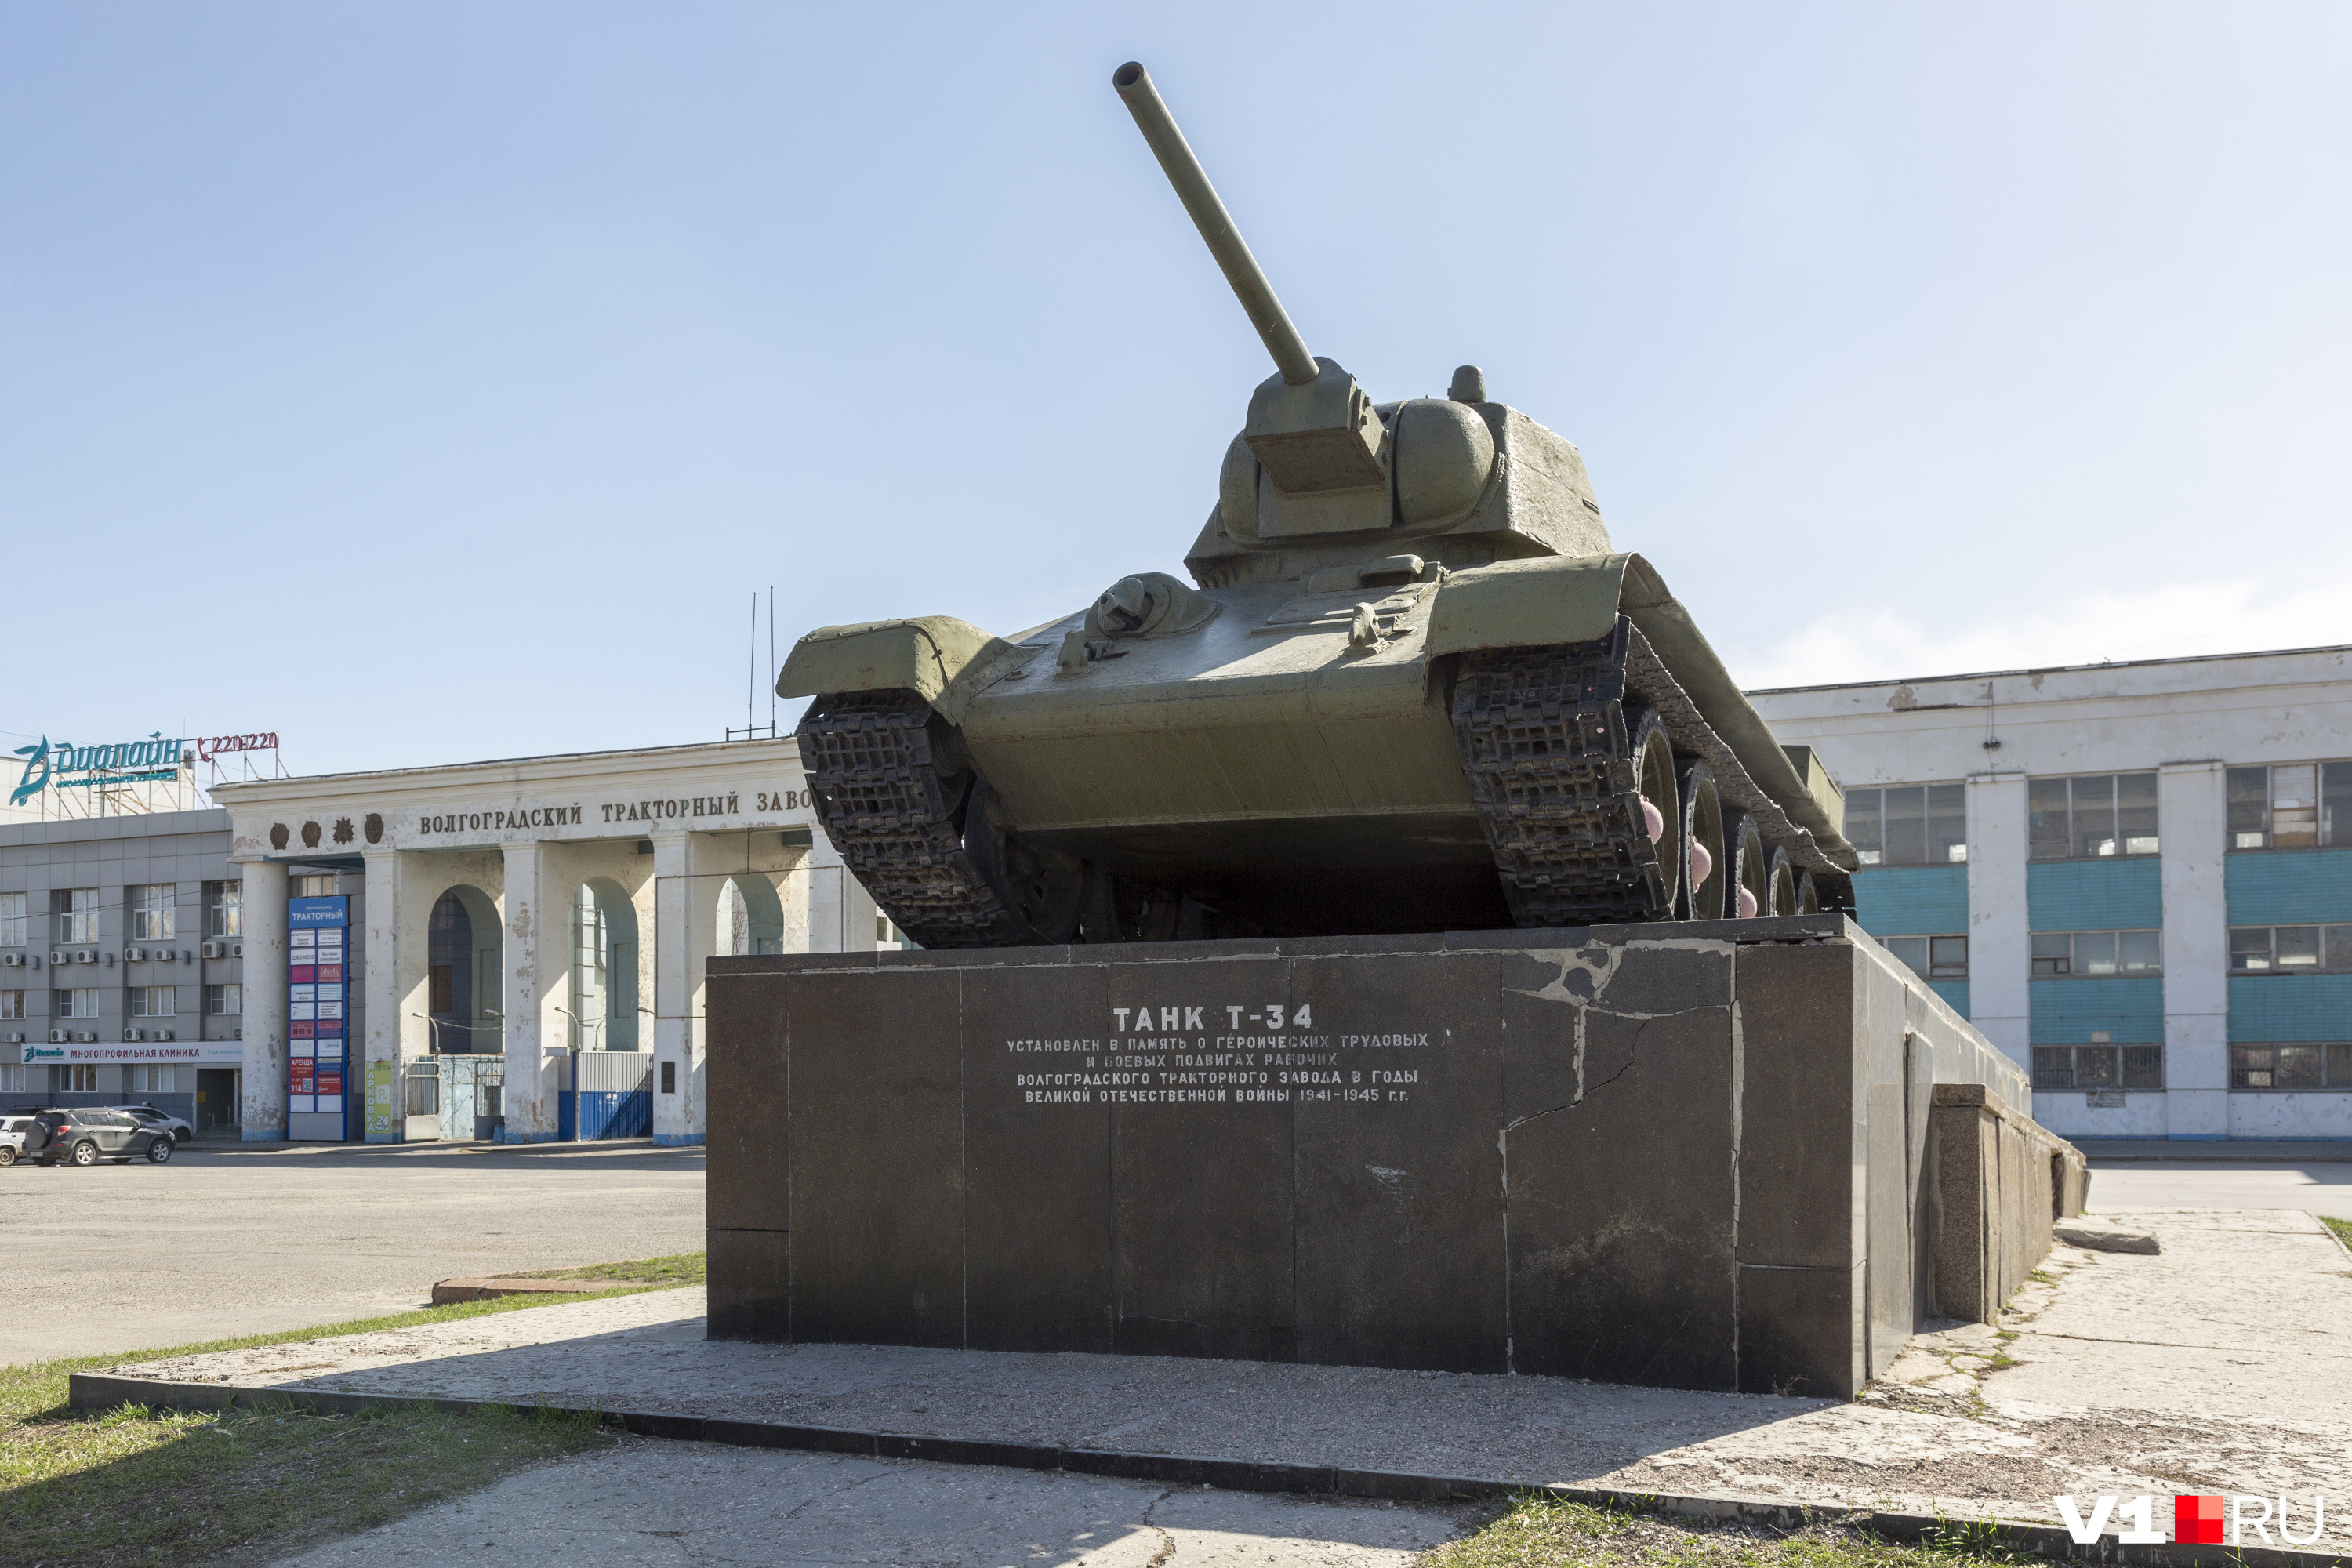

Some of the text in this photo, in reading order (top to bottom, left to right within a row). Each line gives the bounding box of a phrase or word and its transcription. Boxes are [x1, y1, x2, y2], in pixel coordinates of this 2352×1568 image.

[54, 730, 279, 774] Диалайн 220-220
[419, 789, 811, 834] ВОЛГОГРАДСКИЙ ТРАКТОРНЫЙ ЗАВО
[292, 909, 343, 921] ТРАКТОРНЫЙ
[1113, 1004, 1312, 1032] ТАНК Т-34
[1007, 1033, 1428, 1052] УСТАНОВЛЕН В ПАМЯТЬ О ГЕРОИЧЕСКИХ ТРУДОВЫХ
[71, 1048, 156, 1058] МНОГОПРОФИЛЬНАЯ
[159, 1048, 200, 1058] КЛИНИКА
[1087, 1052, 1338, 1068] И БОЕВЫХ ПОДВИГАХ РАБОЧИХ
[1017, 1070, 1417, 1086] ВОЛГОГРАДСКОГО ТРАКТОРНОГО ЗАВОДА В ГОДЫ
[1025, 1087, 1091, 1102] ВЕЛИКОЙ
[1100, 1085, 1226, 1102] ОТЕЧЕСТВЕННОЙ
[1236, 1085, 1290, 1102] ВОЙНЫ
[1301, 1089, 1380, 1102] 1941-1945
[376, 1114, 389, 1126] 24
